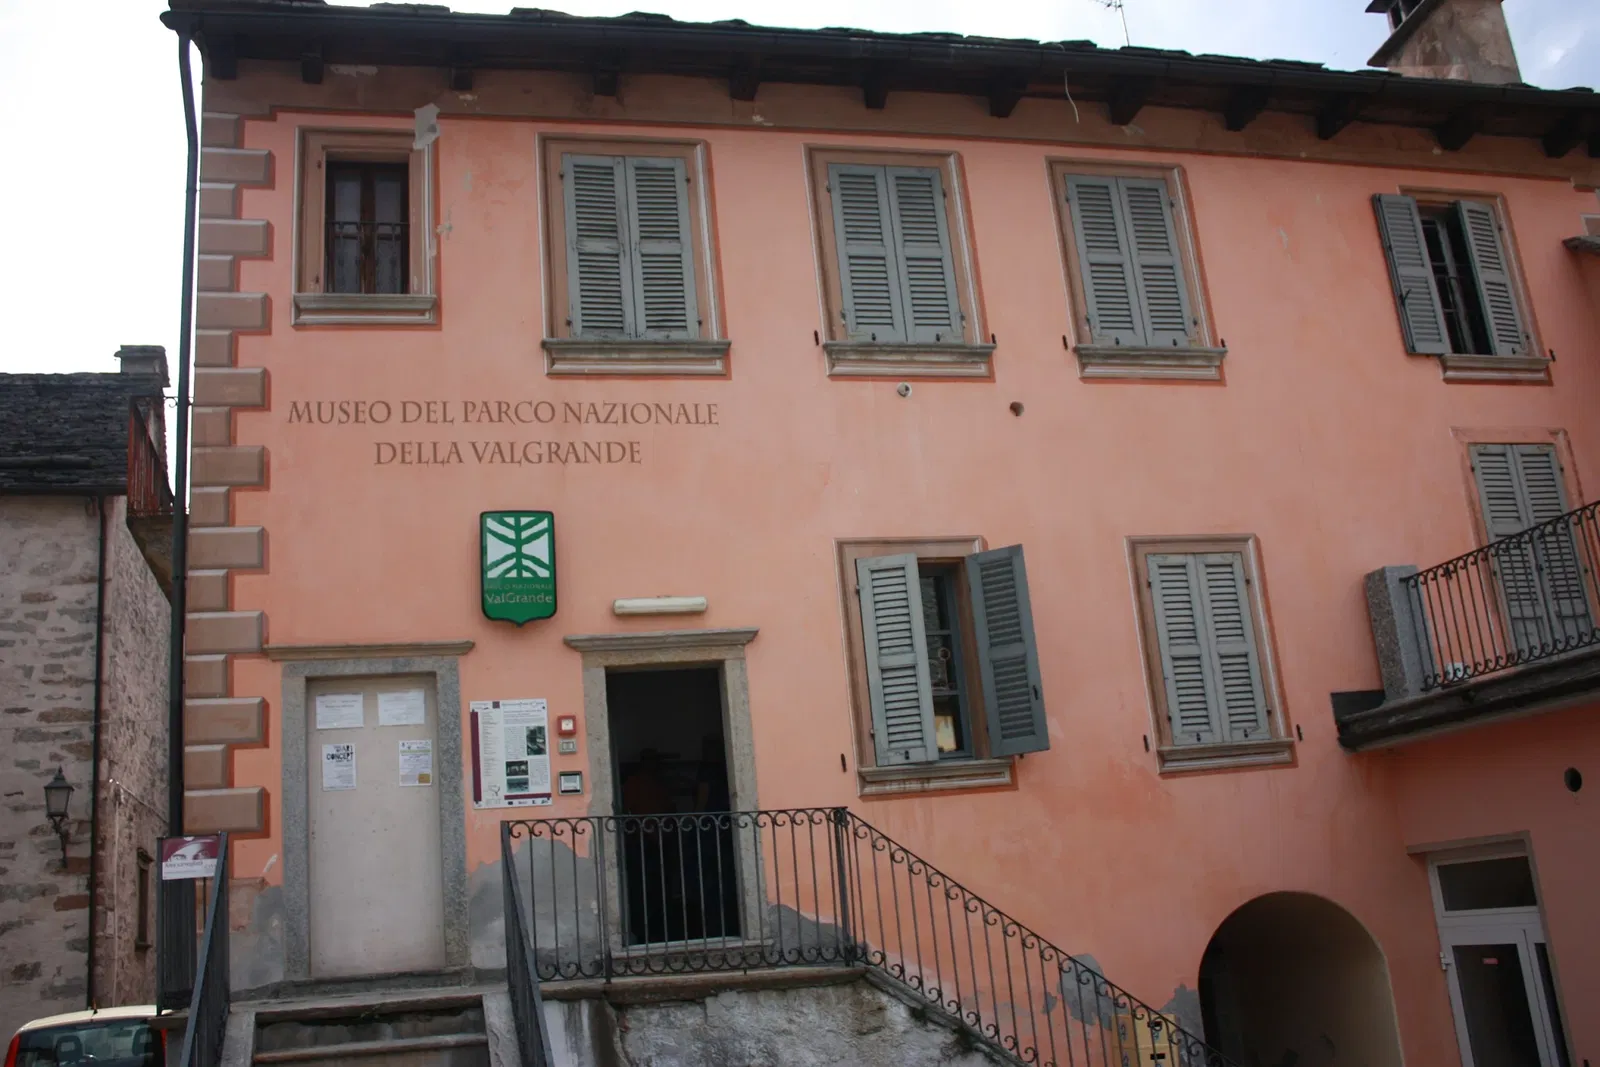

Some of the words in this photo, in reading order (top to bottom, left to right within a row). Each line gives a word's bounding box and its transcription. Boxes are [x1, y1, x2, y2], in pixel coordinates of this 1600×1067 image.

[287, 400, 392, 425] MUSEO
[399, 400, 455, 425] DEL
[462, 400, 556, 425] PARCO
[563, 401, 720, 426] NAZIONALE
[374, 441, 464, 465] DELLA
[467, 441, 642, 467] VALGRANDE
[485, 592, 553, 604] ValGrande
